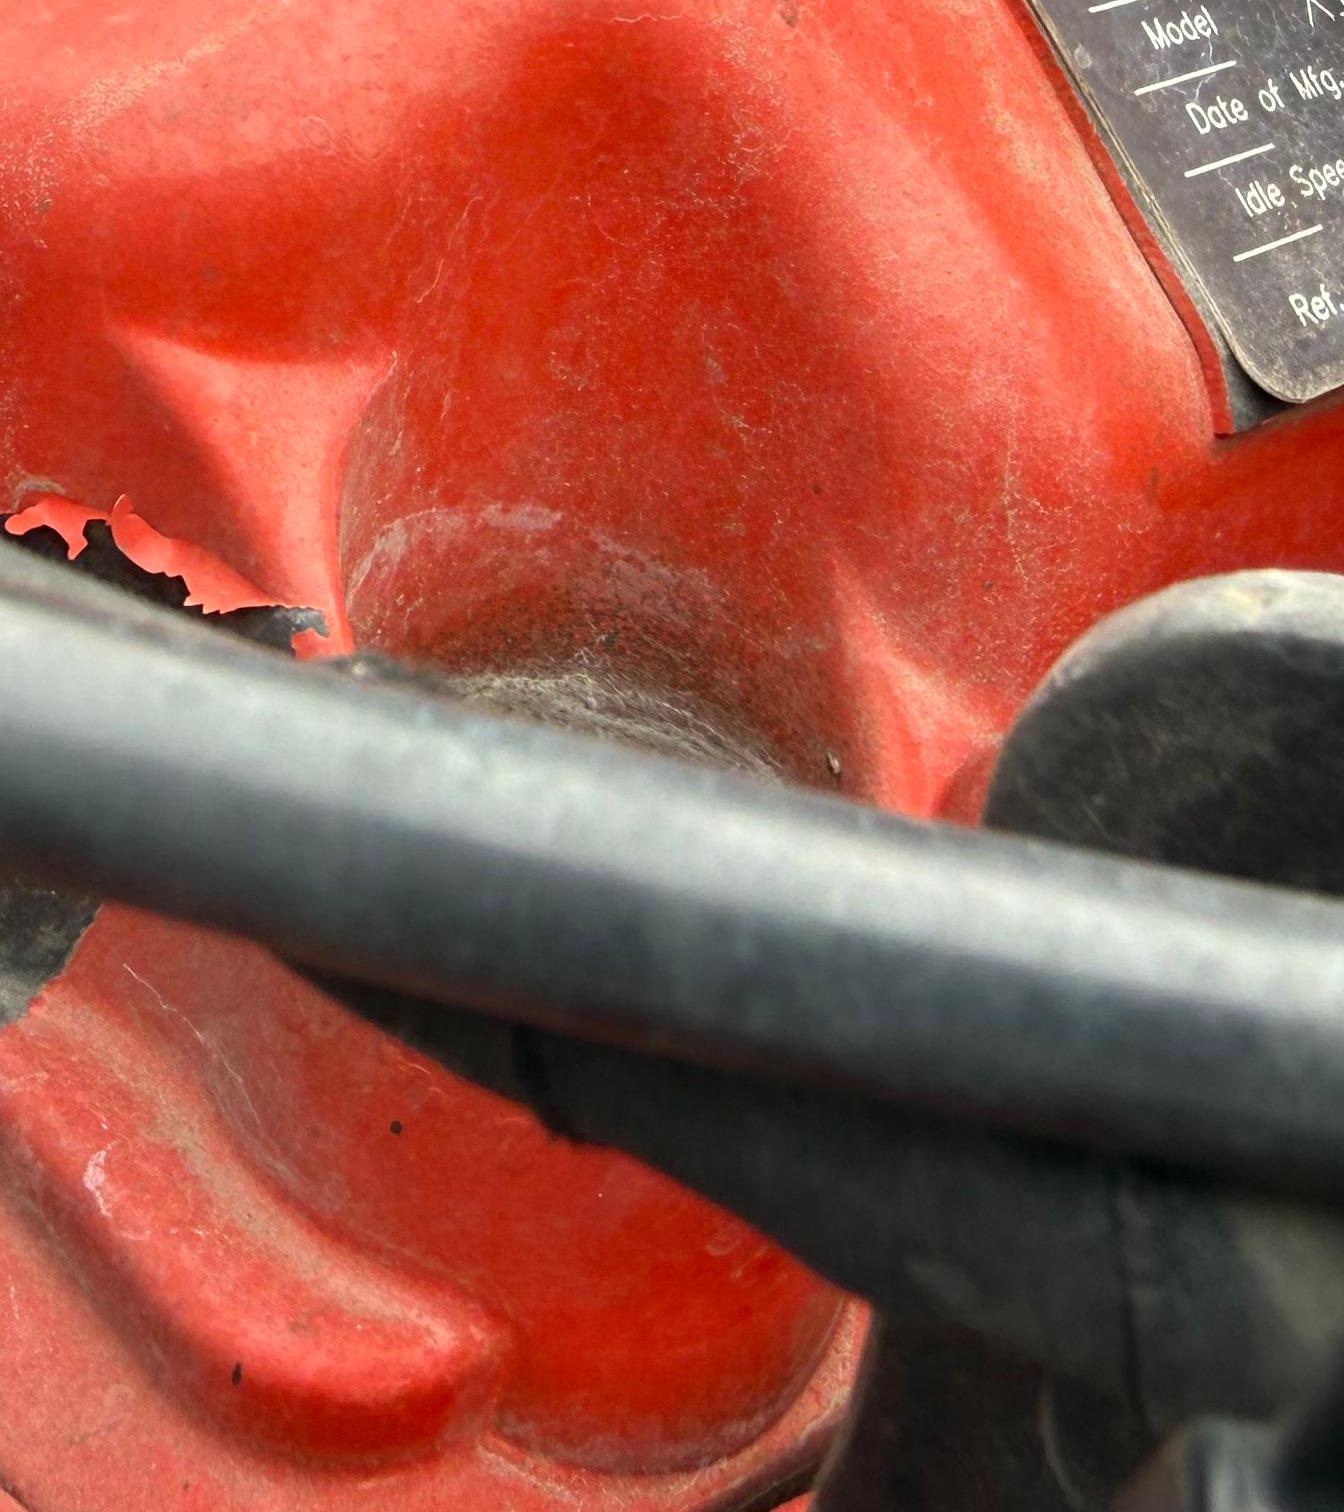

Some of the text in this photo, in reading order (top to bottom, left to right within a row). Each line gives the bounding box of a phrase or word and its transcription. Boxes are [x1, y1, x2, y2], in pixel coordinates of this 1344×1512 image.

[1142, 7, 1218, 53] Model
[1185, 100, 1249, 135] Date
[1258, 78, 1285, 113] of
[1234, 178, 1286, 219] Idle
